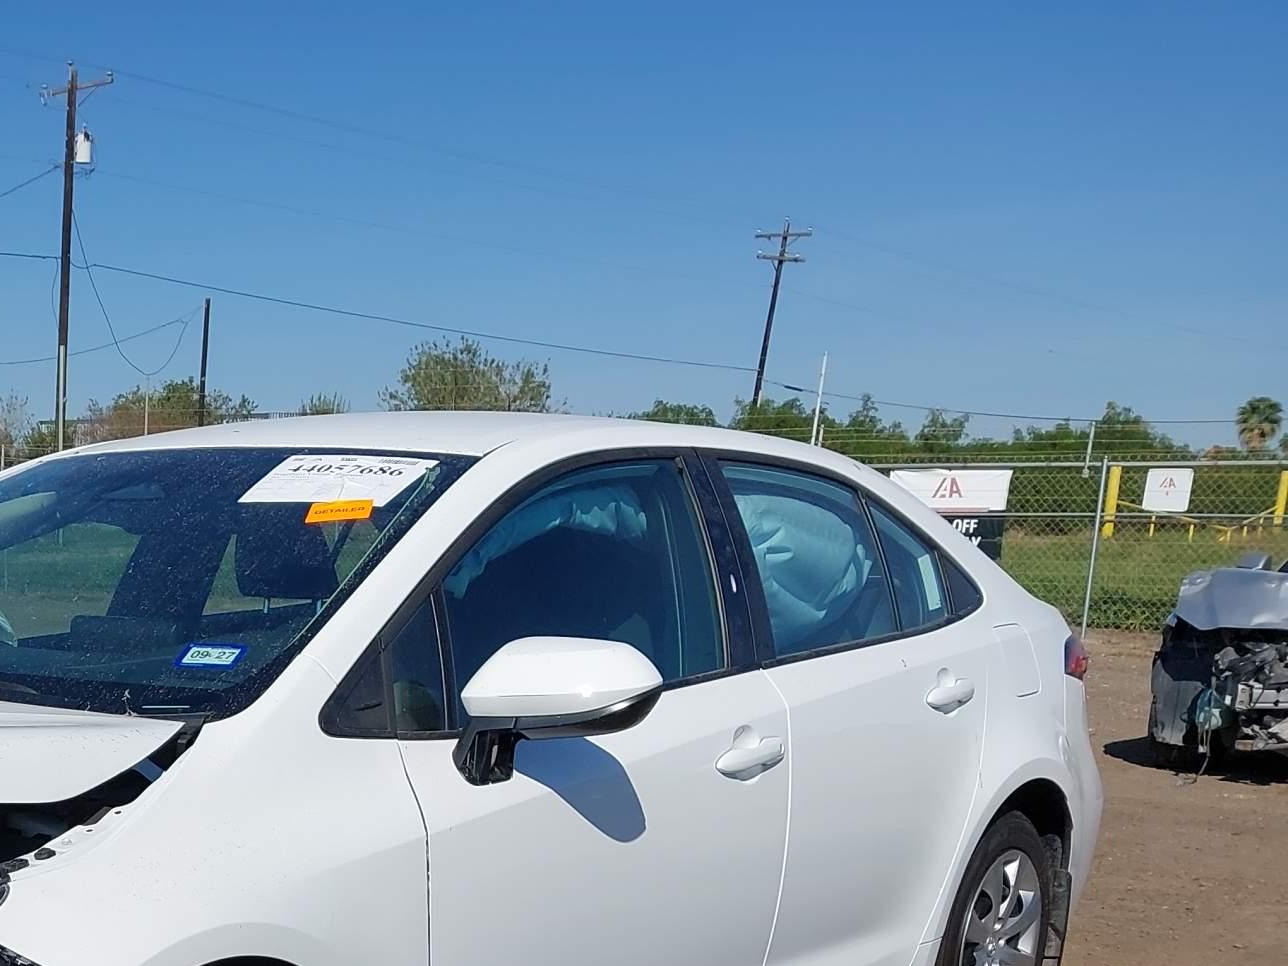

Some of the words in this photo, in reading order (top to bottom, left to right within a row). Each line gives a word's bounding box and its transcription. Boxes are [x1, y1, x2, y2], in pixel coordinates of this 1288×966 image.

[288, 464, 405, 477] 44057686
[314, 506, 366, 515] DETAILED
[952, 519, 978, 533] OFF
